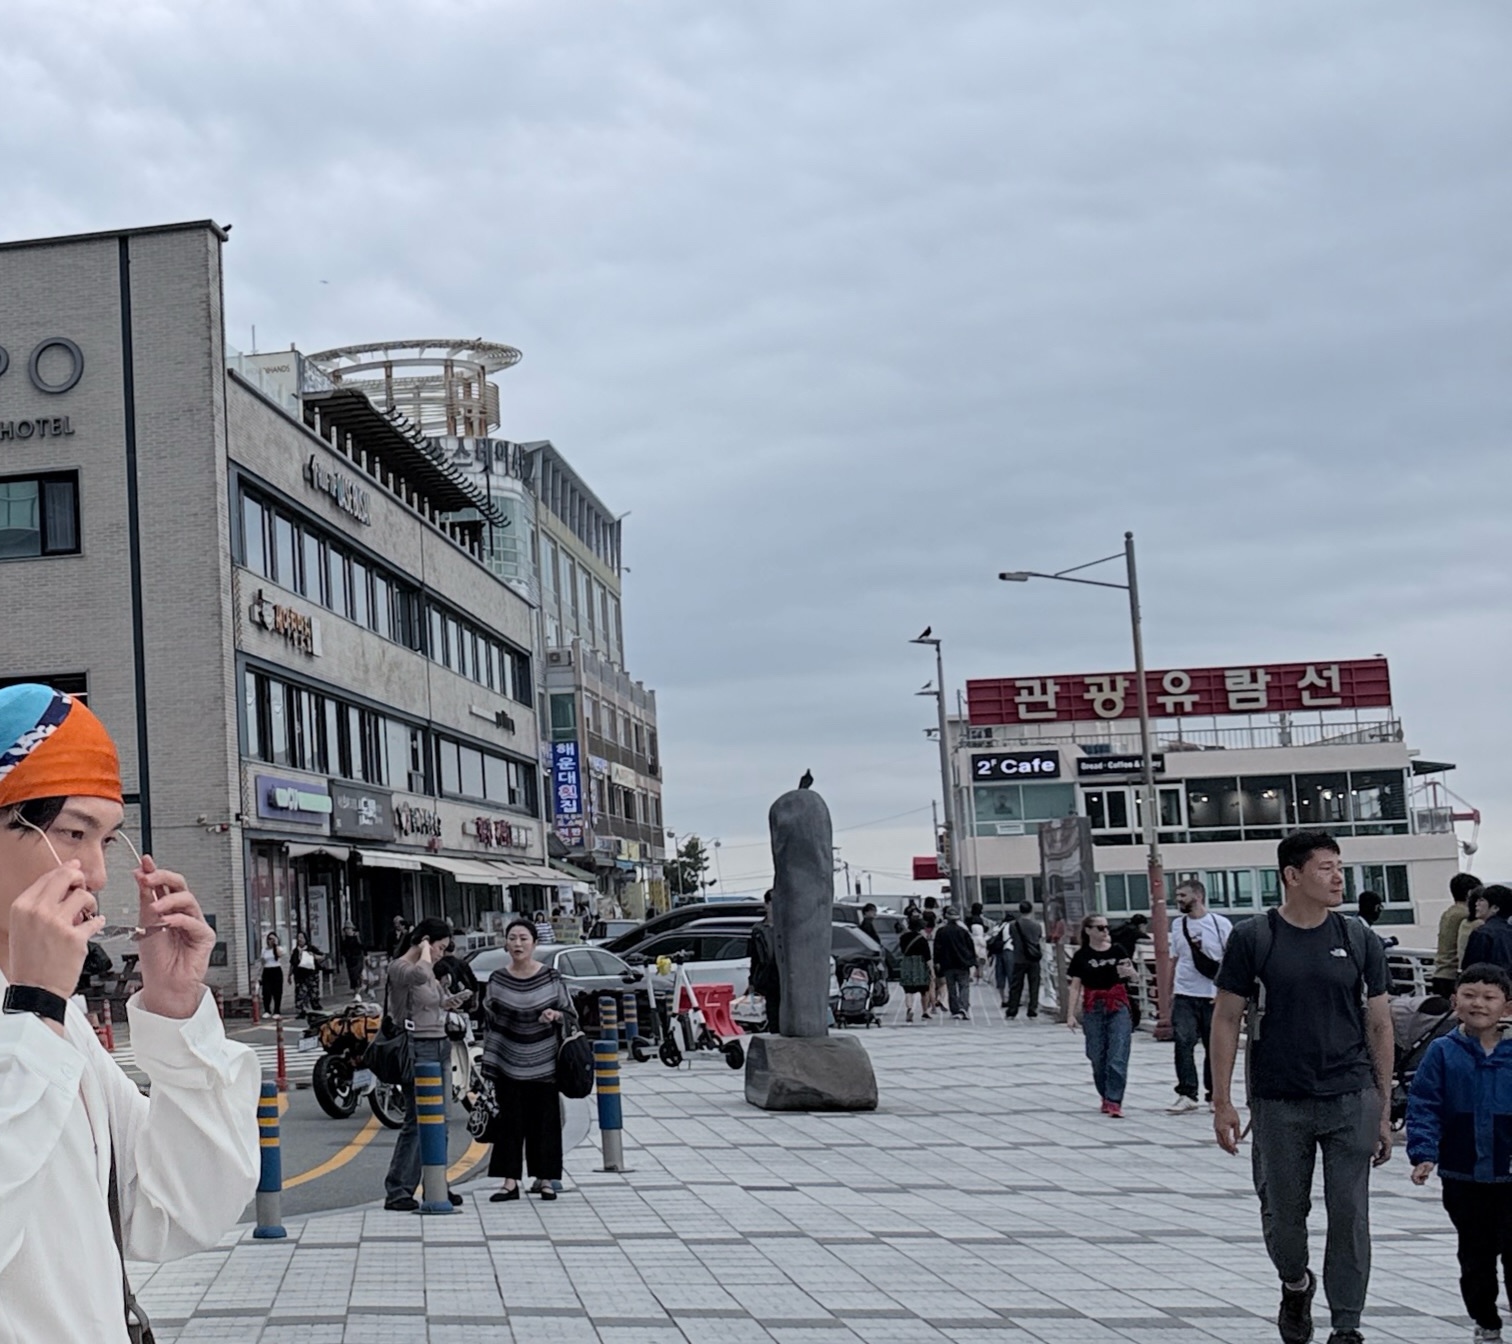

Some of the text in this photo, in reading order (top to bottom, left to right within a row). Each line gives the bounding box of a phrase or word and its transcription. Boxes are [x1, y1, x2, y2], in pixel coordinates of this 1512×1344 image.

[1013, 664, 1342, 720] 관광유람선
[555, 742, 578, 813] 해운대횟집
[1000, 757, 1055, 775] Cafe
[1080, 761, 1103, 770] Bread
[1108, 760, 1133, 769] Coffee
